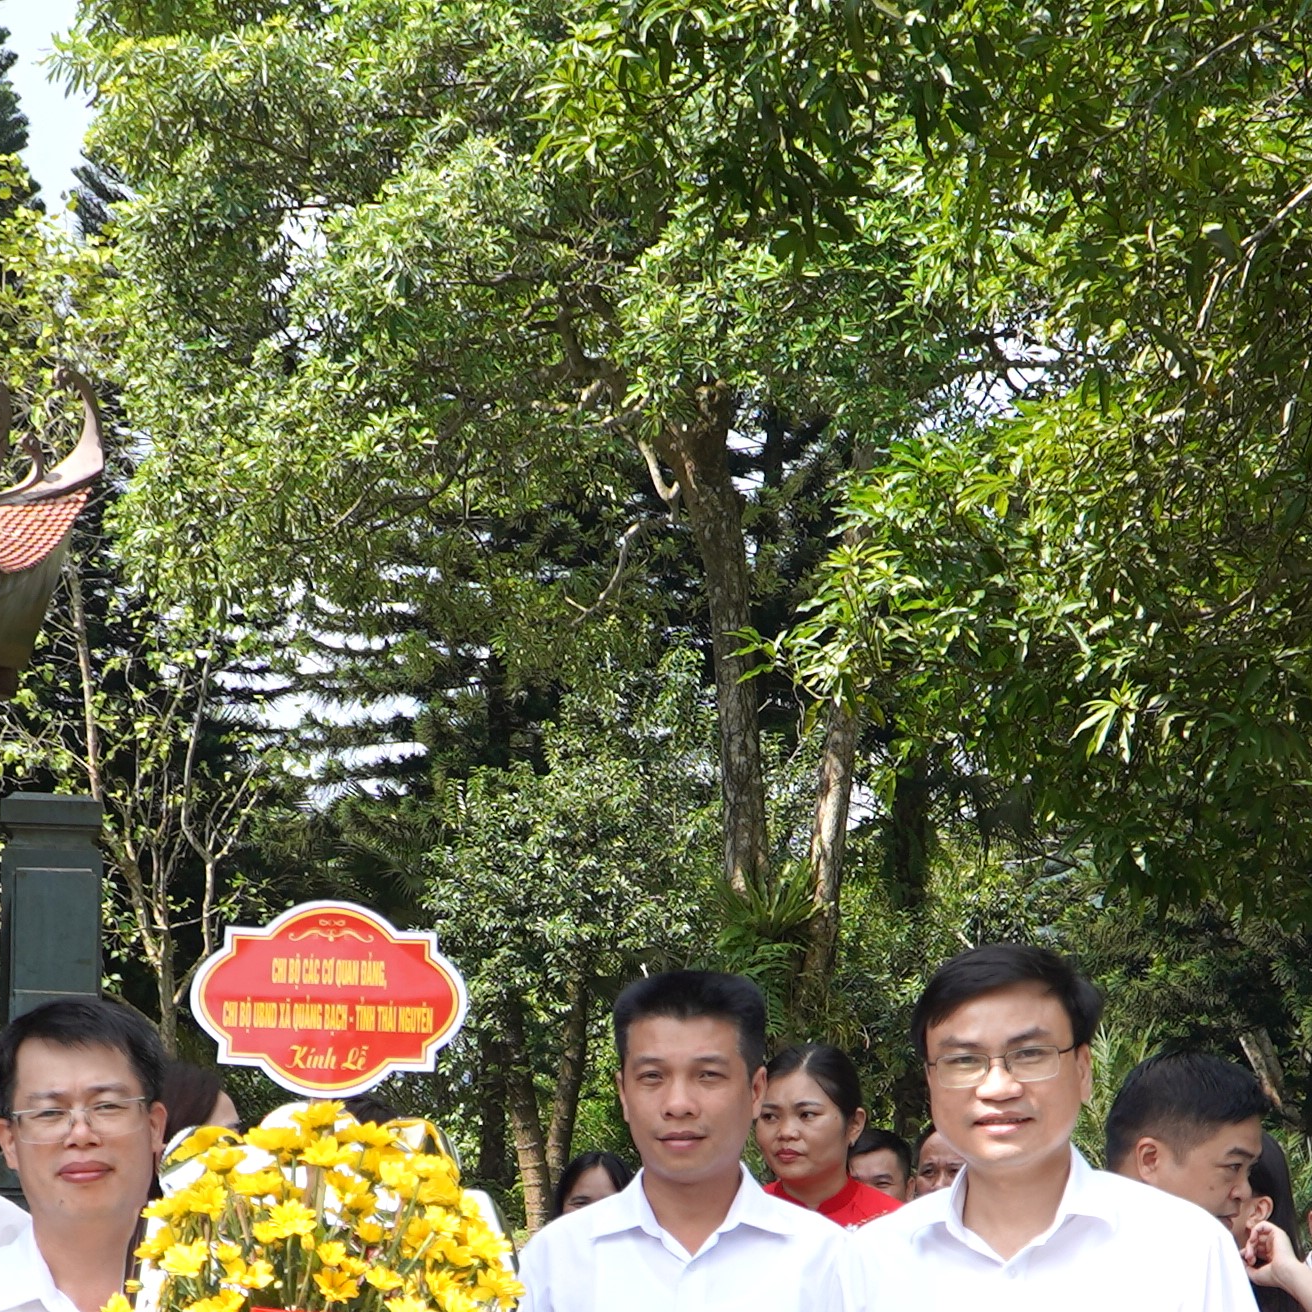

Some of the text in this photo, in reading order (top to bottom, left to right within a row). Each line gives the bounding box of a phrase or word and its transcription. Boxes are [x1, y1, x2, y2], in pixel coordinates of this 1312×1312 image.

[271, 957, 287, 984] CHI
[288, 952, 301, 990] BỘ
[302, 953, 321, 985] CÁC
[321, 957, 336, 985] CƠ
[335, 959, 360, 988] QUAN
[222, 1001, 238, 1027] CHI
[239, 996, 252, 1033] BỘ
[253, 1001, 278, 1028] UBND
[278, 998, 292, 1028] XÃ
[292, 994, 323, 1032] QUẢNG
[323, 1003, 348, 1036] BẠCH
[355, 996, 376, 1031] TỈNH
[377, 1000, 397, 1032] THÁI
[398, 1002, 434, 1034] NGUYÊN
[285, 1045, 369, 1071] Kính Lễ
